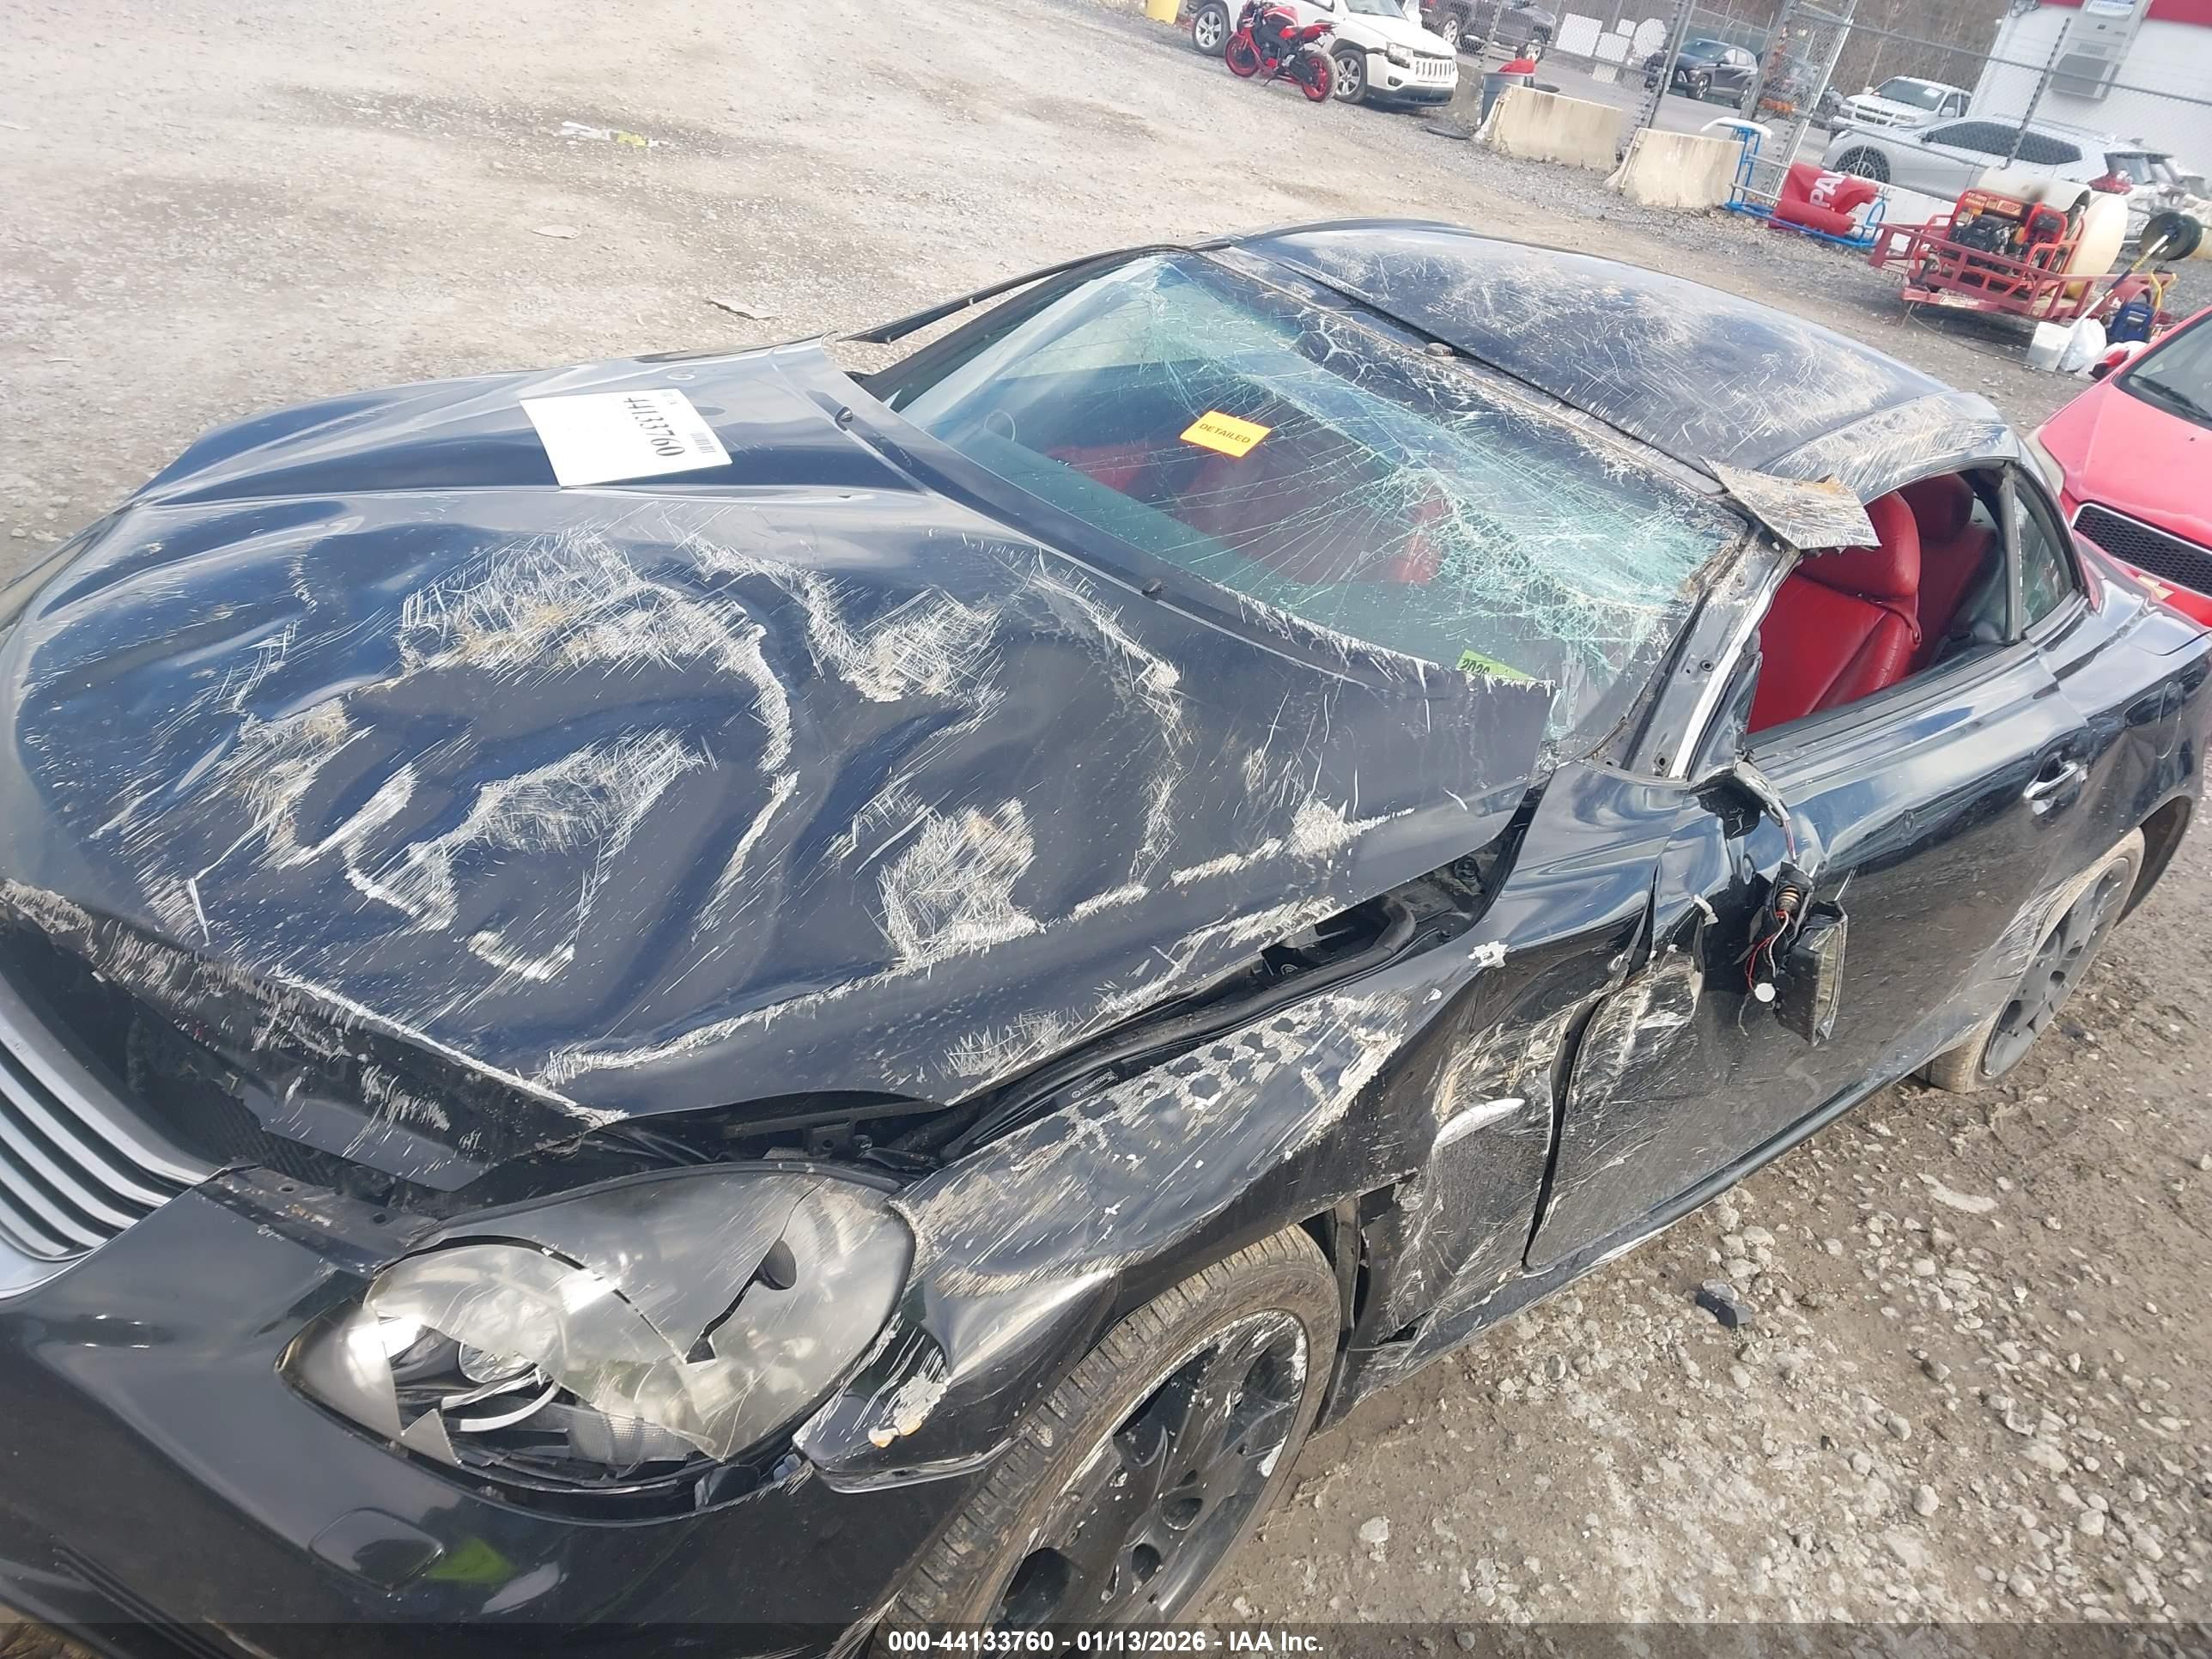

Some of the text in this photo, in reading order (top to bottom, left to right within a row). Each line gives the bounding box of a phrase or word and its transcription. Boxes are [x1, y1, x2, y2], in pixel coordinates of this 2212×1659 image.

[1809, 170, 1849, 209] PA
[623, 398, 686, 457] 44133760
[1199, 423, 1251, 443] DETAILED
